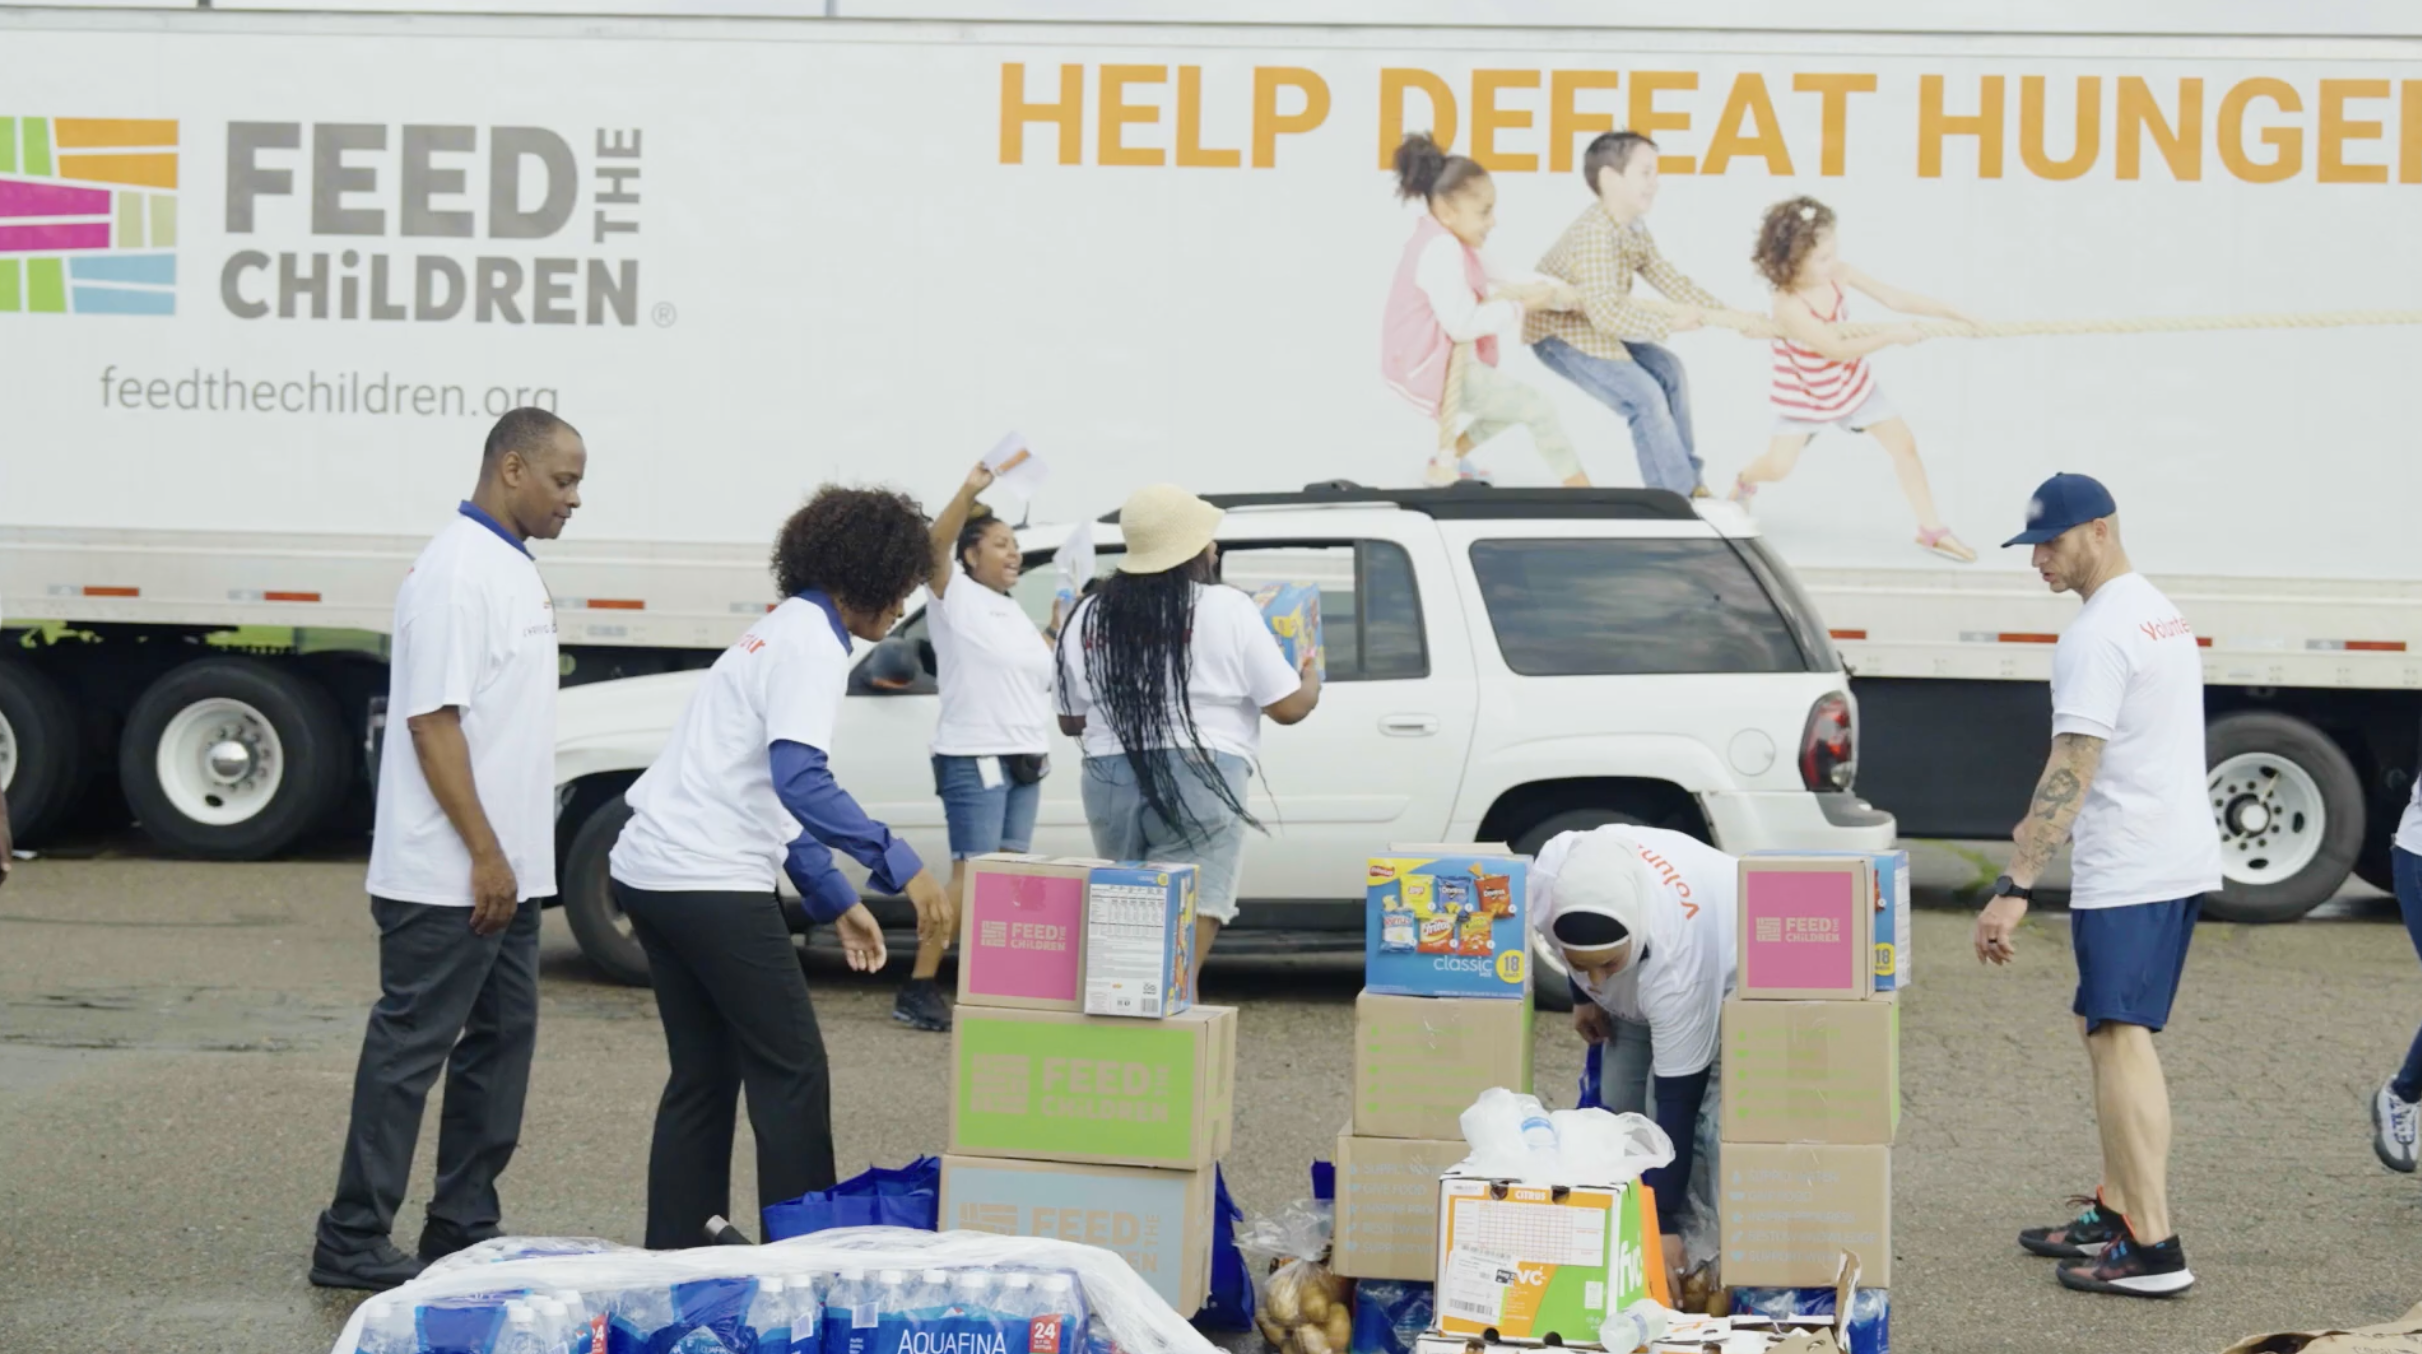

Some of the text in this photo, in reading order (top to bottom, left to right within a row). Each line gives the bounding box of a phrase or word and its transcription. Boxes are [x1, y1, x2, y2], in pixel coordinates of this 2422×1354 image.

[1000, 62, 1332, 170] HELP
[1378, 66, 1878, 177] DEFEAT
[225, 121, 642, 243] FEED THE
[100, 366, 559, 416] feedthechildren.org
[1012, 922, 1058, 941] FEED
[1785, 917, 1832, 932] FEED
[1433, 955, 1520, 972] classic 18
[1042, 1057, 1151, 1097] FEED
[1514, 1189, 1547, 1201] CITRUS
[1031, 1206, 1161, 1246] FEED THE
[898, 1329, 1007, 1354] AQUAFINA
[1034, 1321, 1056, 1339] 24
